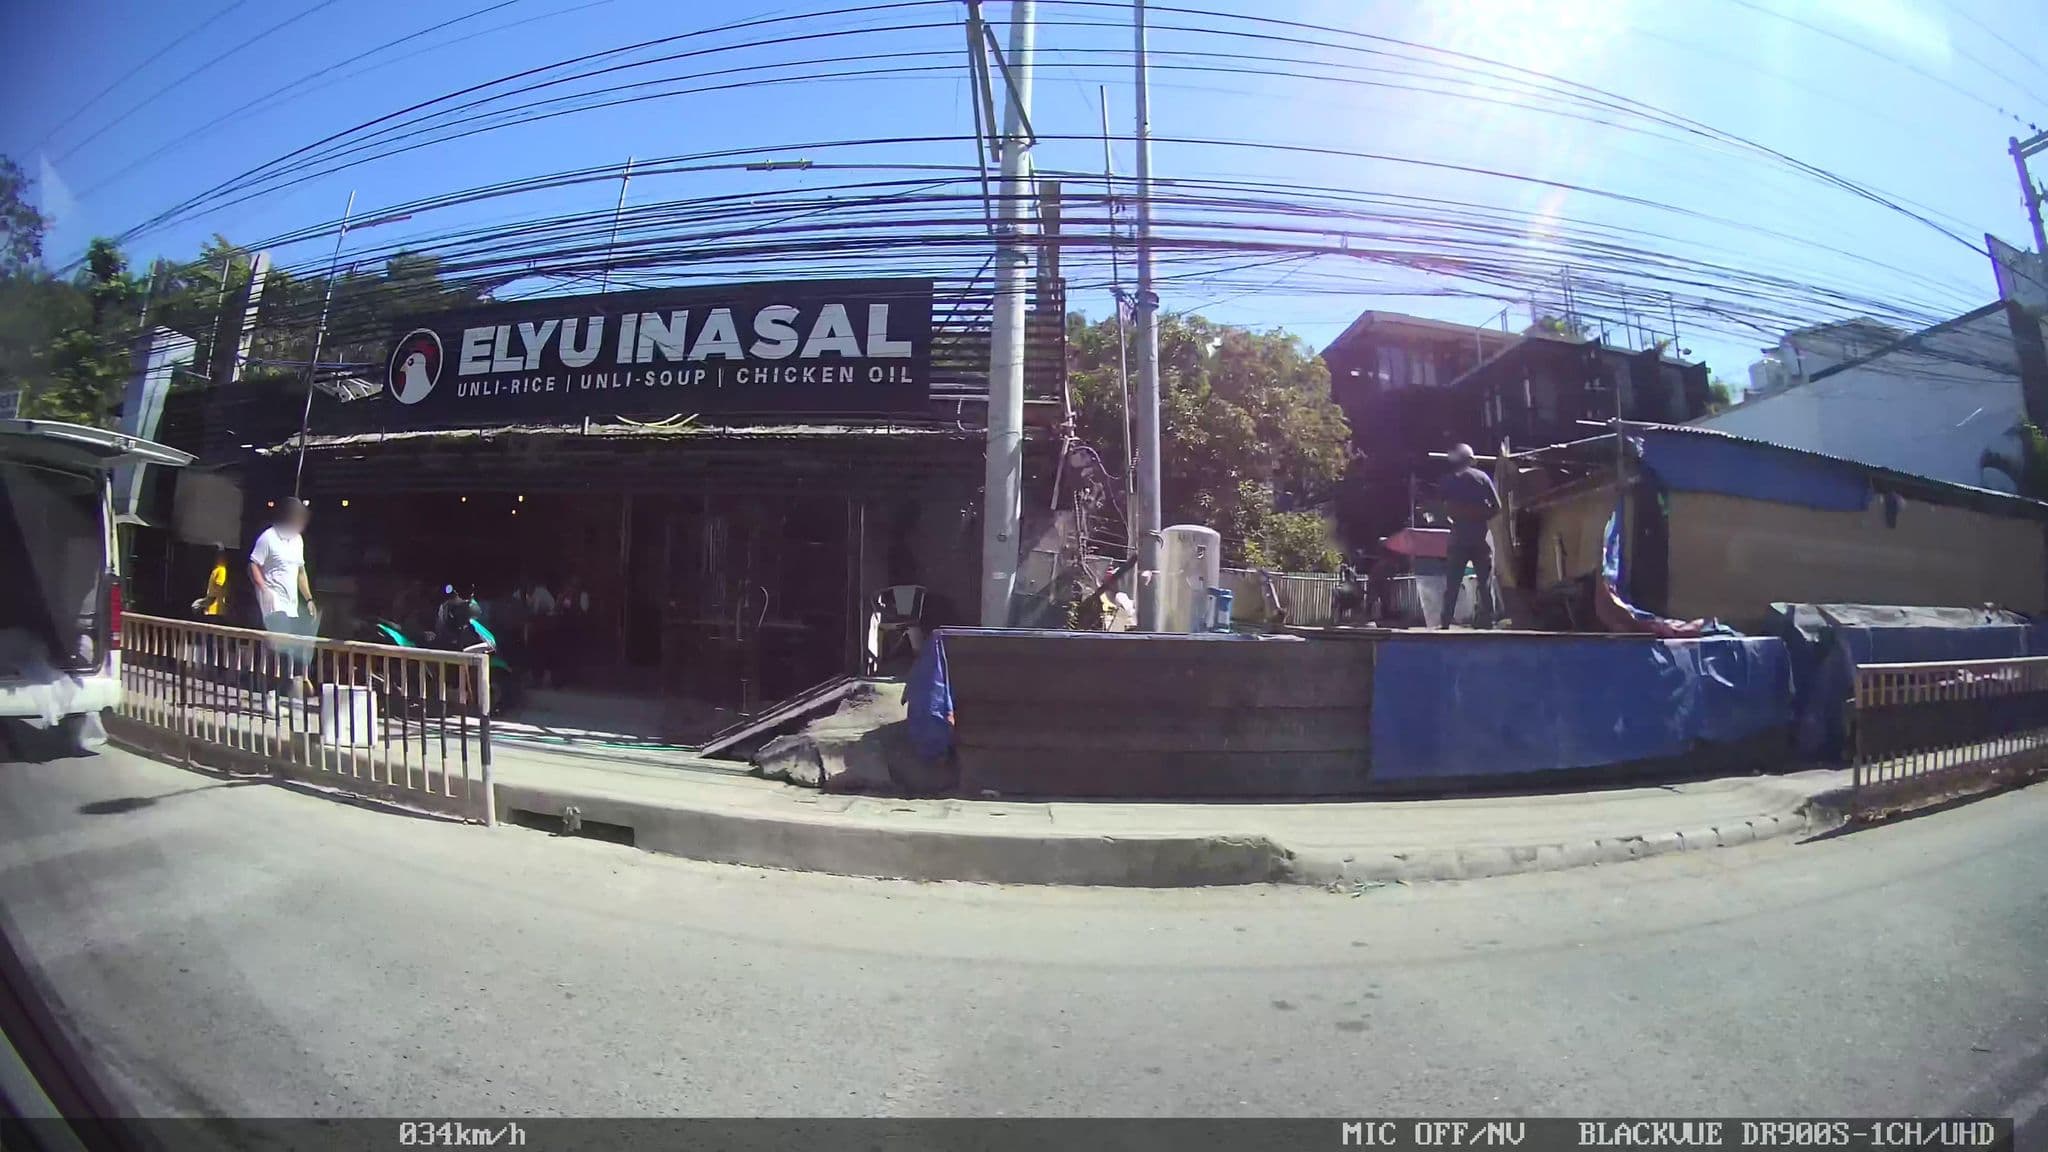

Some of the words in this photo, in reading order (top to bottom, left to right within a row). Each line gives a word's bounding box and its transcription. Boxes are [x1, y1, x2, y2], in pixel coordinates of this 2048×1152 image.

[458, 315, 604, 376] ELYU
[616, 303, 912, 364] INASAL
[457, 377, 555, 397] UNLI-RICE
[580, 370, 706, 389] UNLI-SOUP
[736, 366, 854, 384] CHICKEN
[868, 366, 913, 383] OIL
